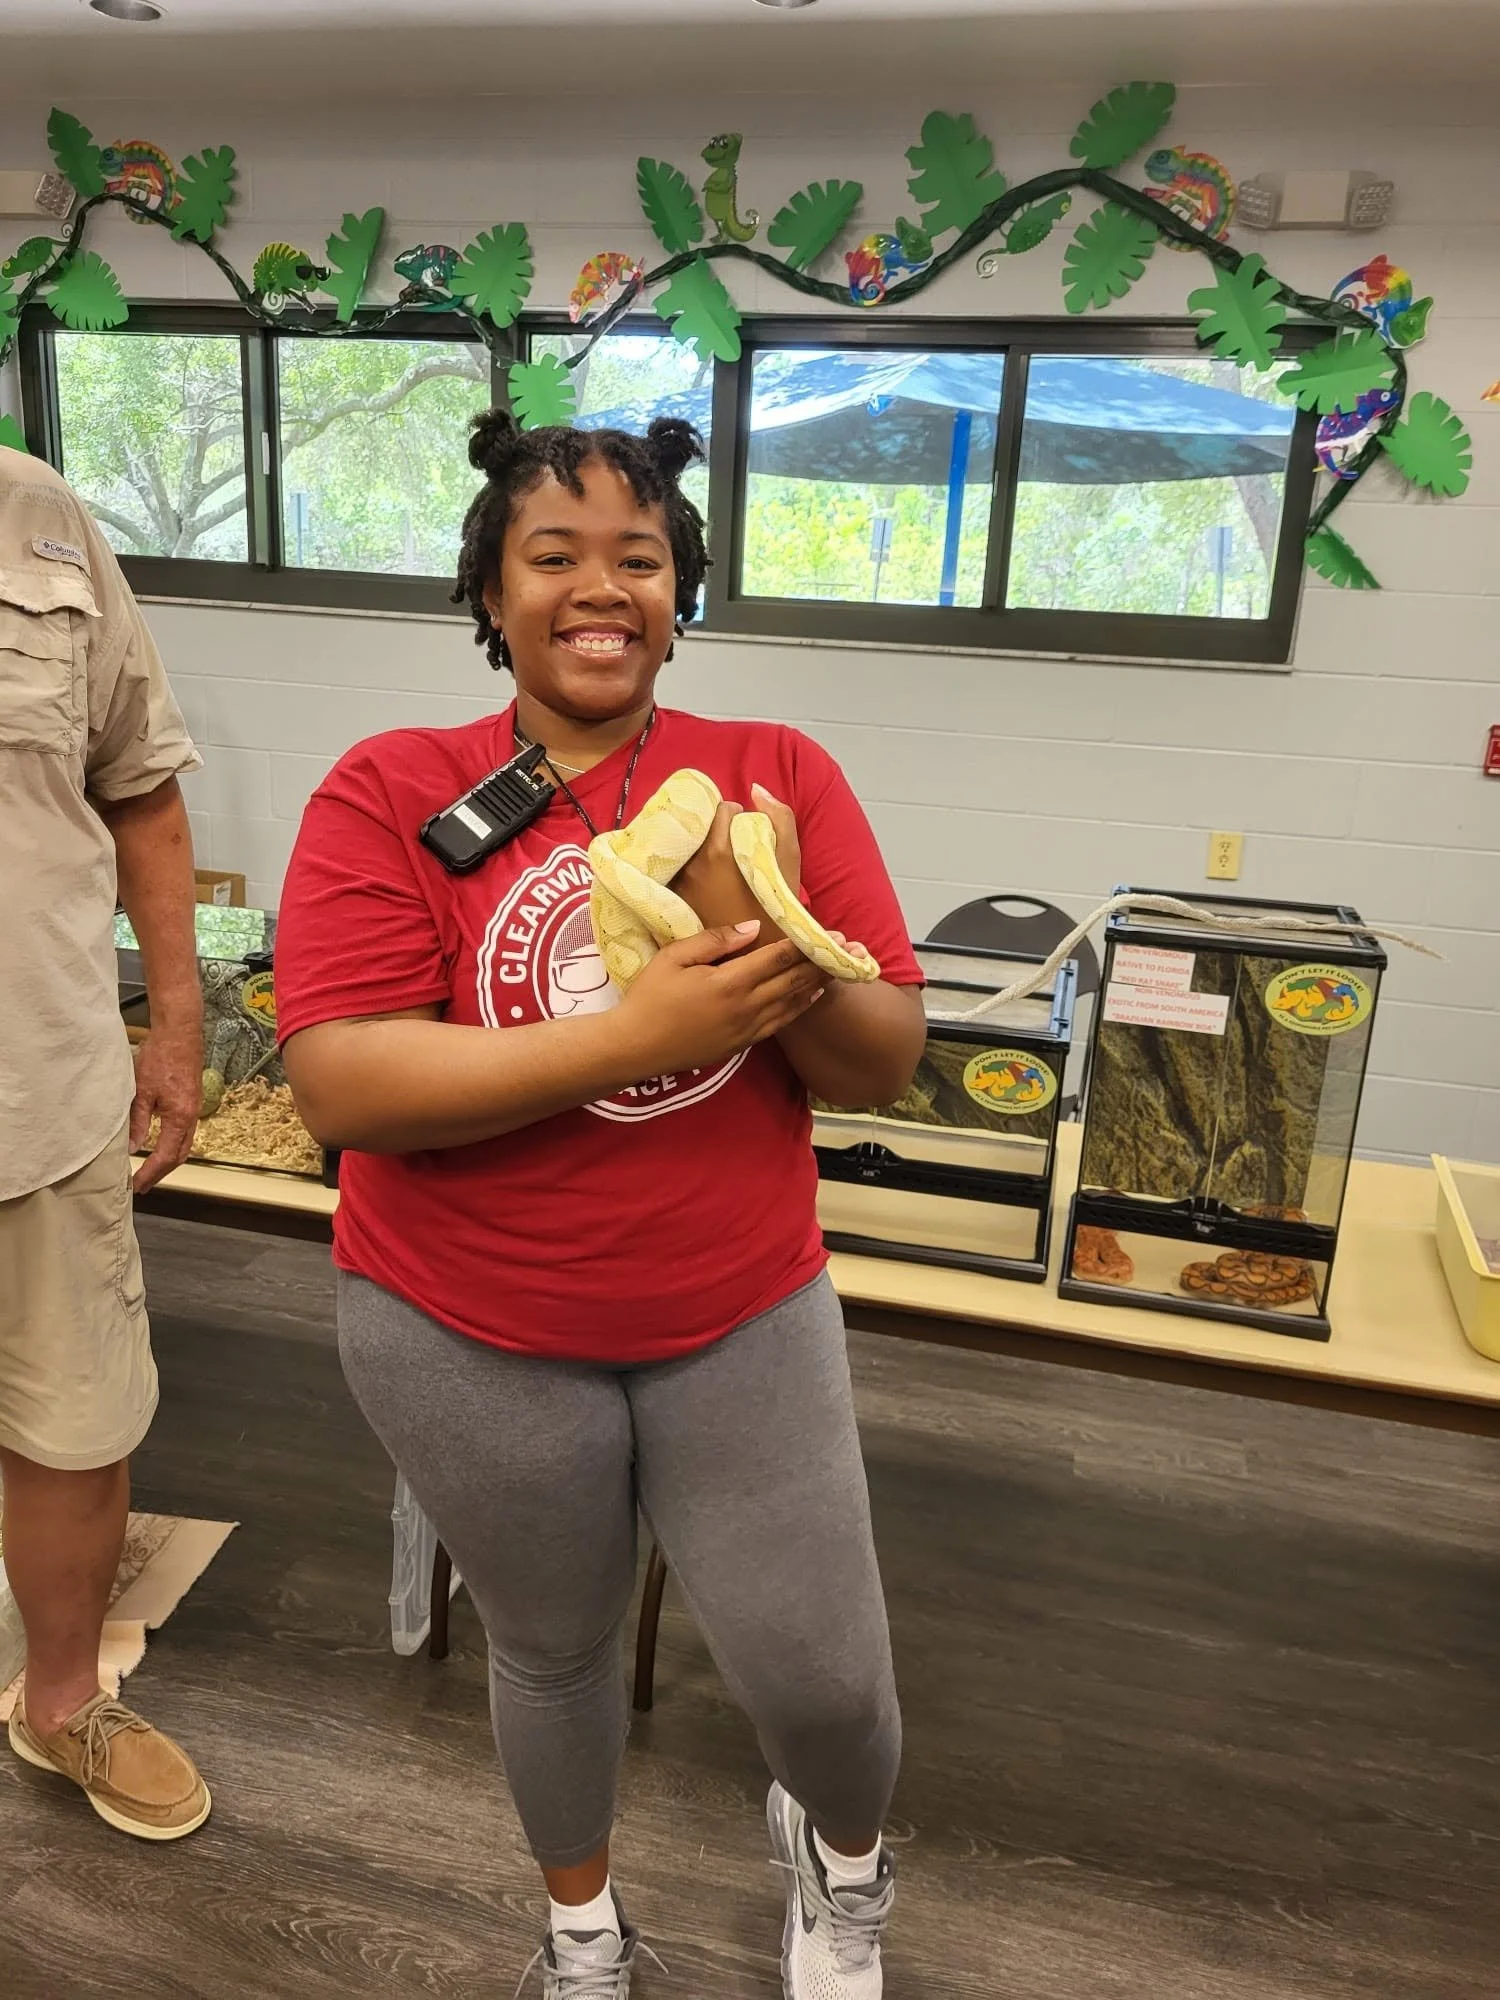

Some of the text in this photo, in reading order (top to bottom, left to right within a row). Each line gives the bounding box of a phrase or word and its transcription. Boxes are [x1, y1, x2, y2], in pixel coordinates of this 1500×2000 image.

[500, 862, 595, 984] CLEARWA
[1115, 960, 1190, 976] NATIVE TO FLORIDA
[1107, 997, 1225, 1018] EXOTIC FROM SOUTH AMERICA
[618, 1075, 678, 1097] ACE
